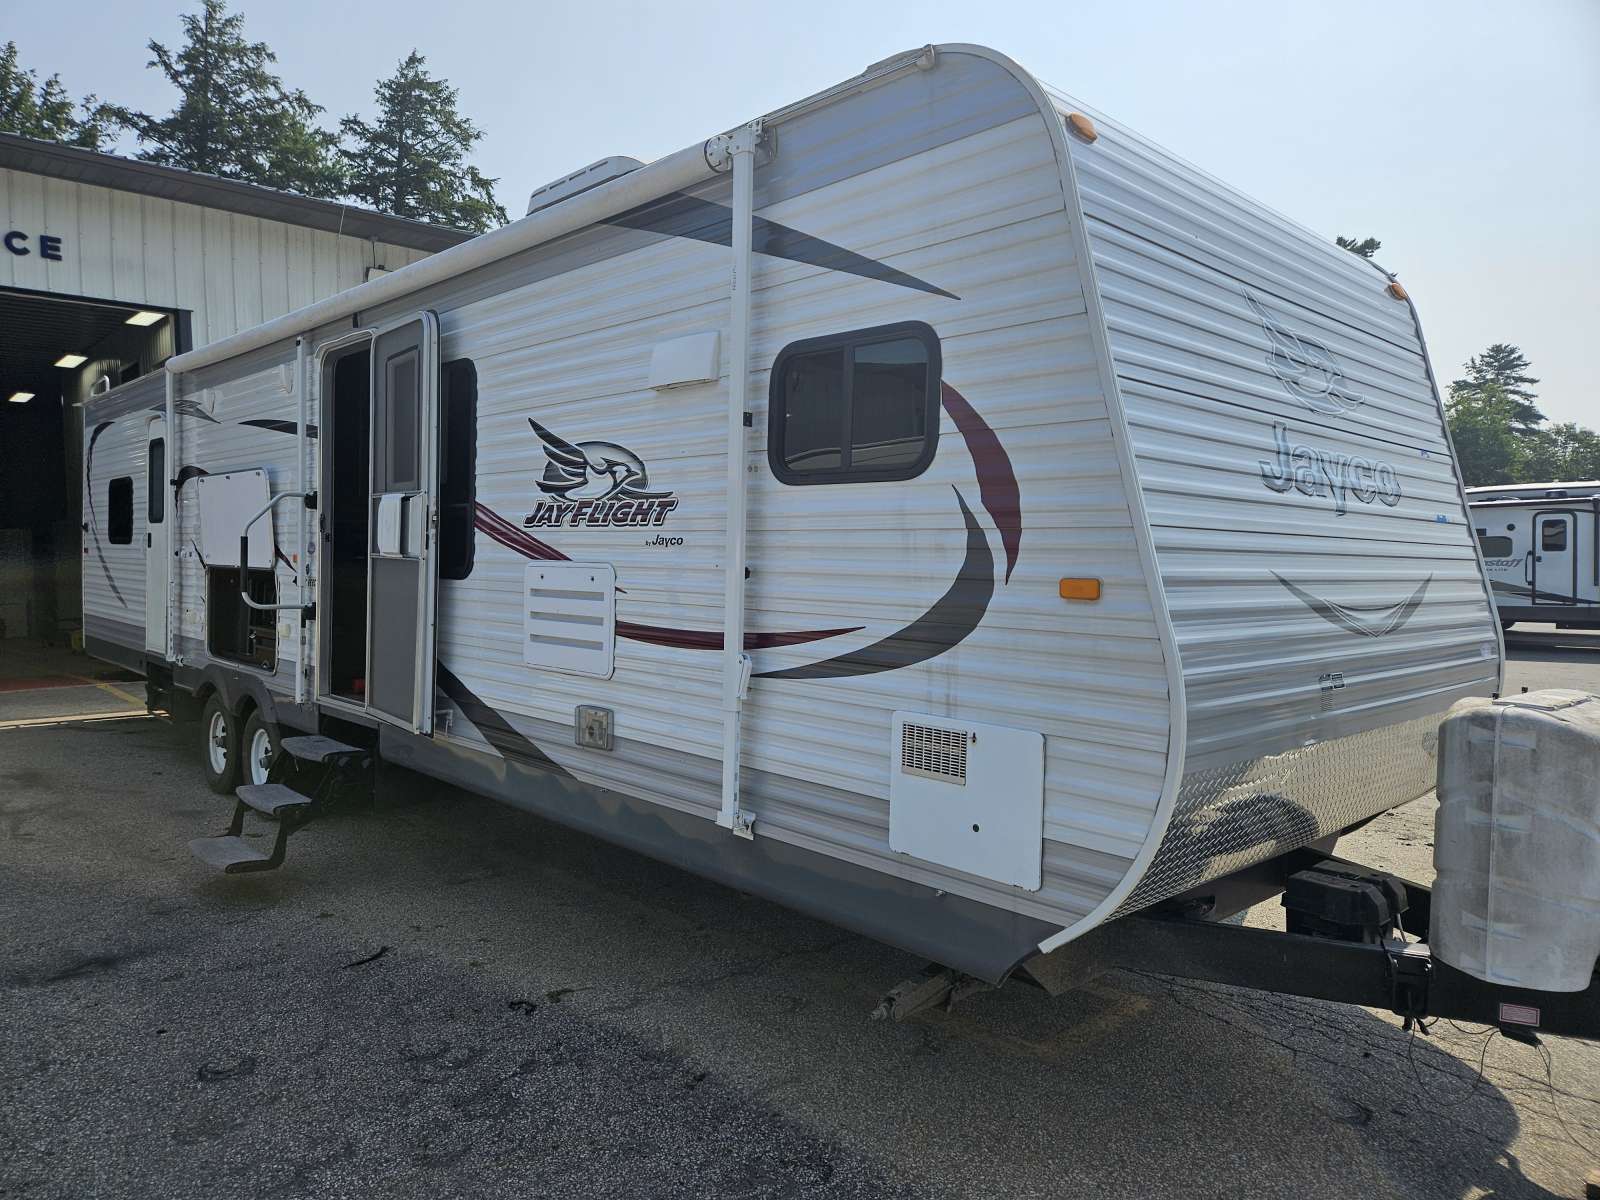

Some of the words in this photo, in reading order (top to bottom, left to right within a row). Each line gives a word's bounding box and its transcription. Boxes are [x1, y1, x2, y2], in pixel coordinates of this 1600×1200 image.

[4, 231, 62, 261] CE
[1258, 419, 1402, 517] Jayco
[652, 534, 684, 548] Jayco
